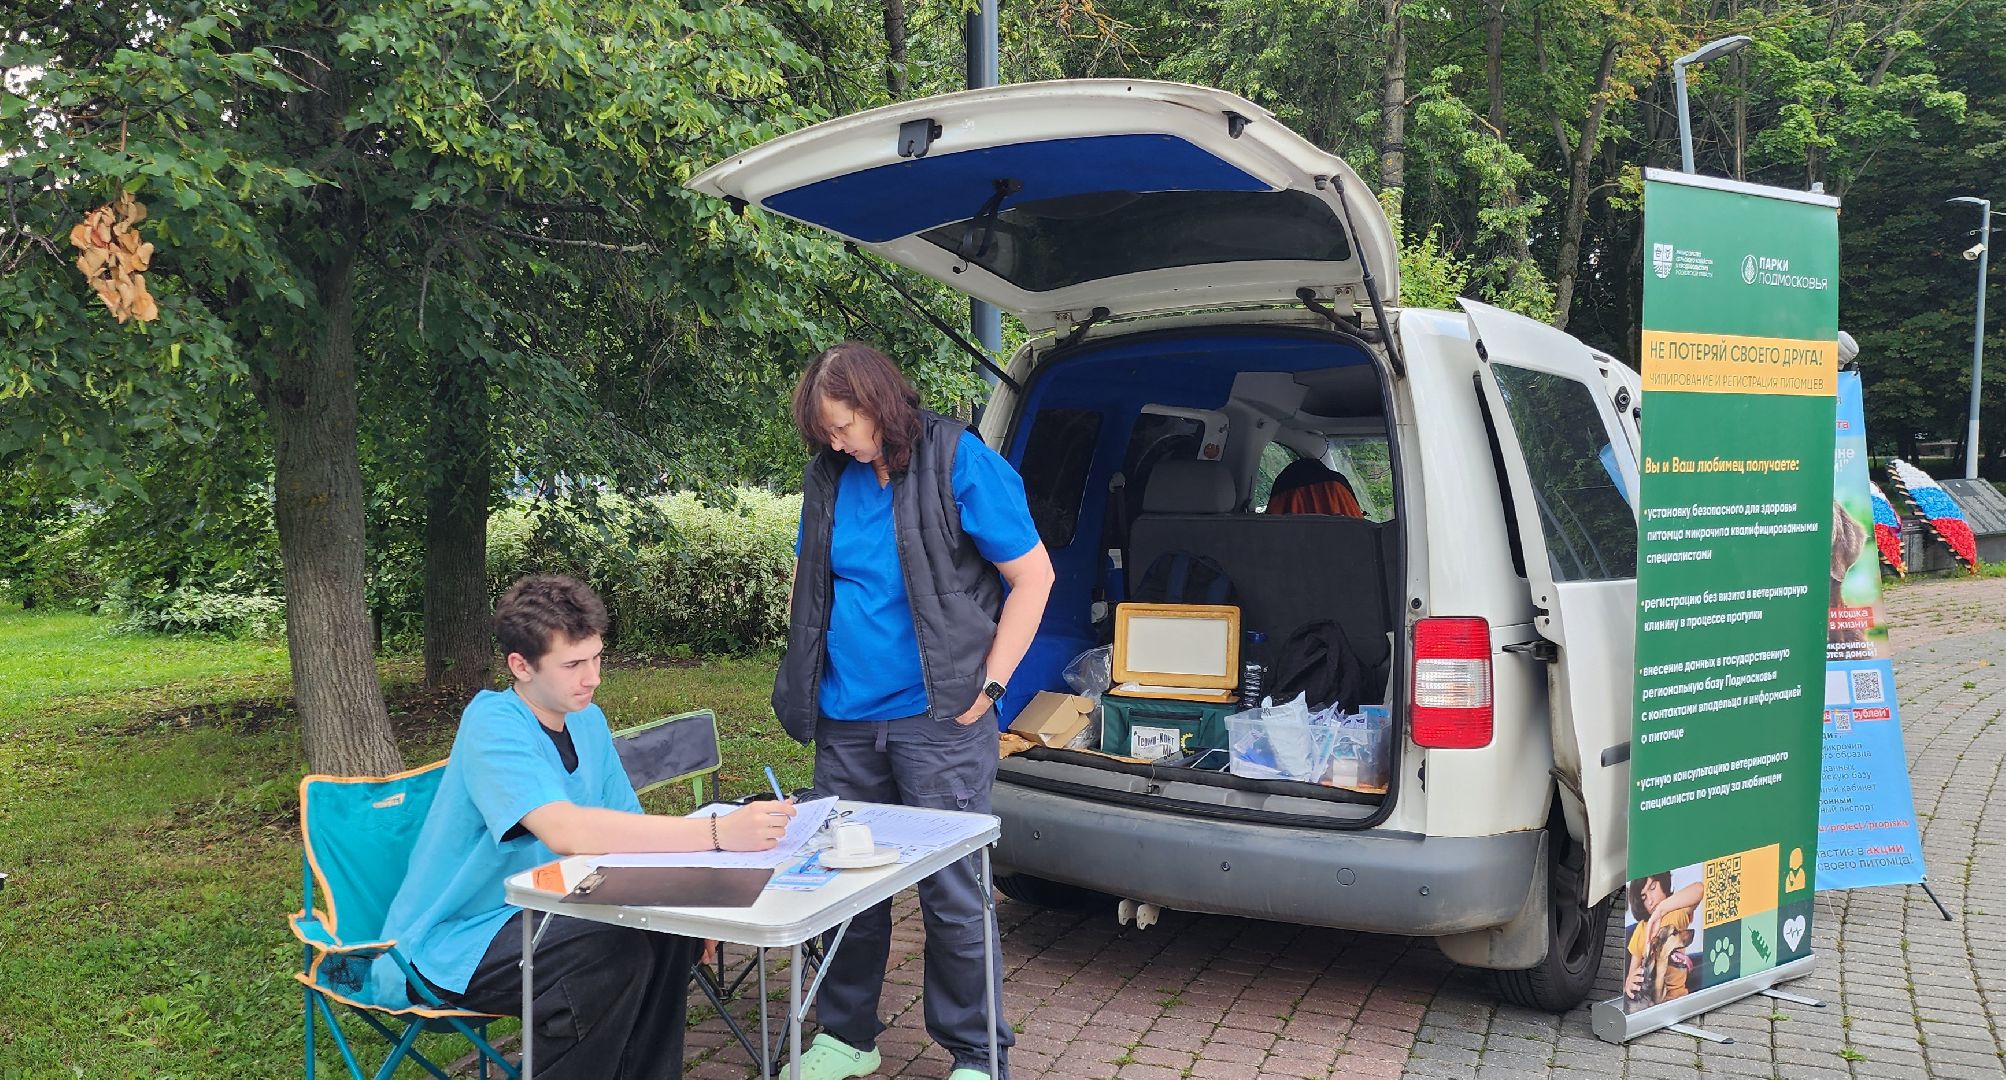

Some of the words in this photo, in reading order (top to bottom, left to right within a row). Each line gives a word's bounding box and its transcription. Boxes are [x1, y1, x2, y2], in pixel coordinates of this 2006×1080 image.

[1759, 256, 1789, 272] ПАРКИ
[1758, 271, 1828, 291] ПОДМОСКОВЬЯ
[1650, 341, 1665, 359] НЕ
[1668, 339, 1727, 362] ПОТЕРЯЙ
[1730, 344, 1780, 364] СВОЕГО
[1782, 348, 1823, 368] ДРУГА!
[1649, 373, 1713, 387] ЧИПИРОВАНИЕ
[1714, 375, 1721, 387] И
[1722, 375, 1778, 390] РЕГИСТРАЦИЯ
[1780, 377, 1824, 390] ПИТОМЦЕВ
[1645, 456, 1660, 474] Вы
[1662, 461, 1669, 473] и
[1672, 456, 1695, 473] Ваш
[1697, 456, 1745, 475] любимец
[1746, 459, 1800, 475] получаете:
[1647, 506, 1691, 521] установку
[1692, 503, 1744, 517] безопасного
[1744, 504, 1760, 516] для
[1760, 503, 1797, 516] здоровья
[1647, 529, 1684, 541] питомца
[1685, 526, 1729, 542] микрочипа
[1730, 521, 1819, 538] квалифицированными
[1646, 549, 1713, 565] специалистами
[1644, 594, 1702, 612] регистрацию
[1703, 590, 1717, 604] без
[1718, 590, 1746, 602] визита
[1746, 589, 1752, 599] в
[1752, 585, 1808, 600] ветеринарную
[1644, 618, 1679, 632] клинику
[1680, 618, 1686, 628] в
[1686, 613, 1726, 630] процессе
[1726, 610, 1763, 625] прогулки
[1837, 609, 1869, 619] кошка
[1837, 620, 1868, 630] жизни
[1826, 641, 1874, 651] икрочипом
[1643, 662, 1684, 677] внесение
[1684, 658, 1716, 673] данных
[1716, 657, 1722, 667] в
[1722, 648, 1790, 668] государственную
[1642, 681, 1704, 702] региональную
[1705, 676, 1724, 691] базу
[1725, 670, 1777, 688] Подмосковья
[1641, 711, 1648, 722] с
[1648, 703, 1698, 721] контактами
[1698, 696, 1742, 713] владельца
[1743, 695, 1748, 706] и
[1749, 684, 1802, 706] информацией
[1641, 734, 1647, 745] о
[1648, 728, 1685, 743] питомце
[1640, 774, 1672, 791] устную
[1672, 762, 1730, 782] консультацию
[1730, 751, 1789, 771] ветеринарного
[1640, 790, 1695, 811] специалиста
[1696, 788, 1707, 800] по
[1707, 783, 1731, 799] уходу
[1731, 781, 1741, 792] за
[1741, 773, 1783, 790] любимцем
[1857, 847, 1865, 856] в
[1866, 844, 1904, 856] акции
[1859, 853, 1914, 868] питомца!
